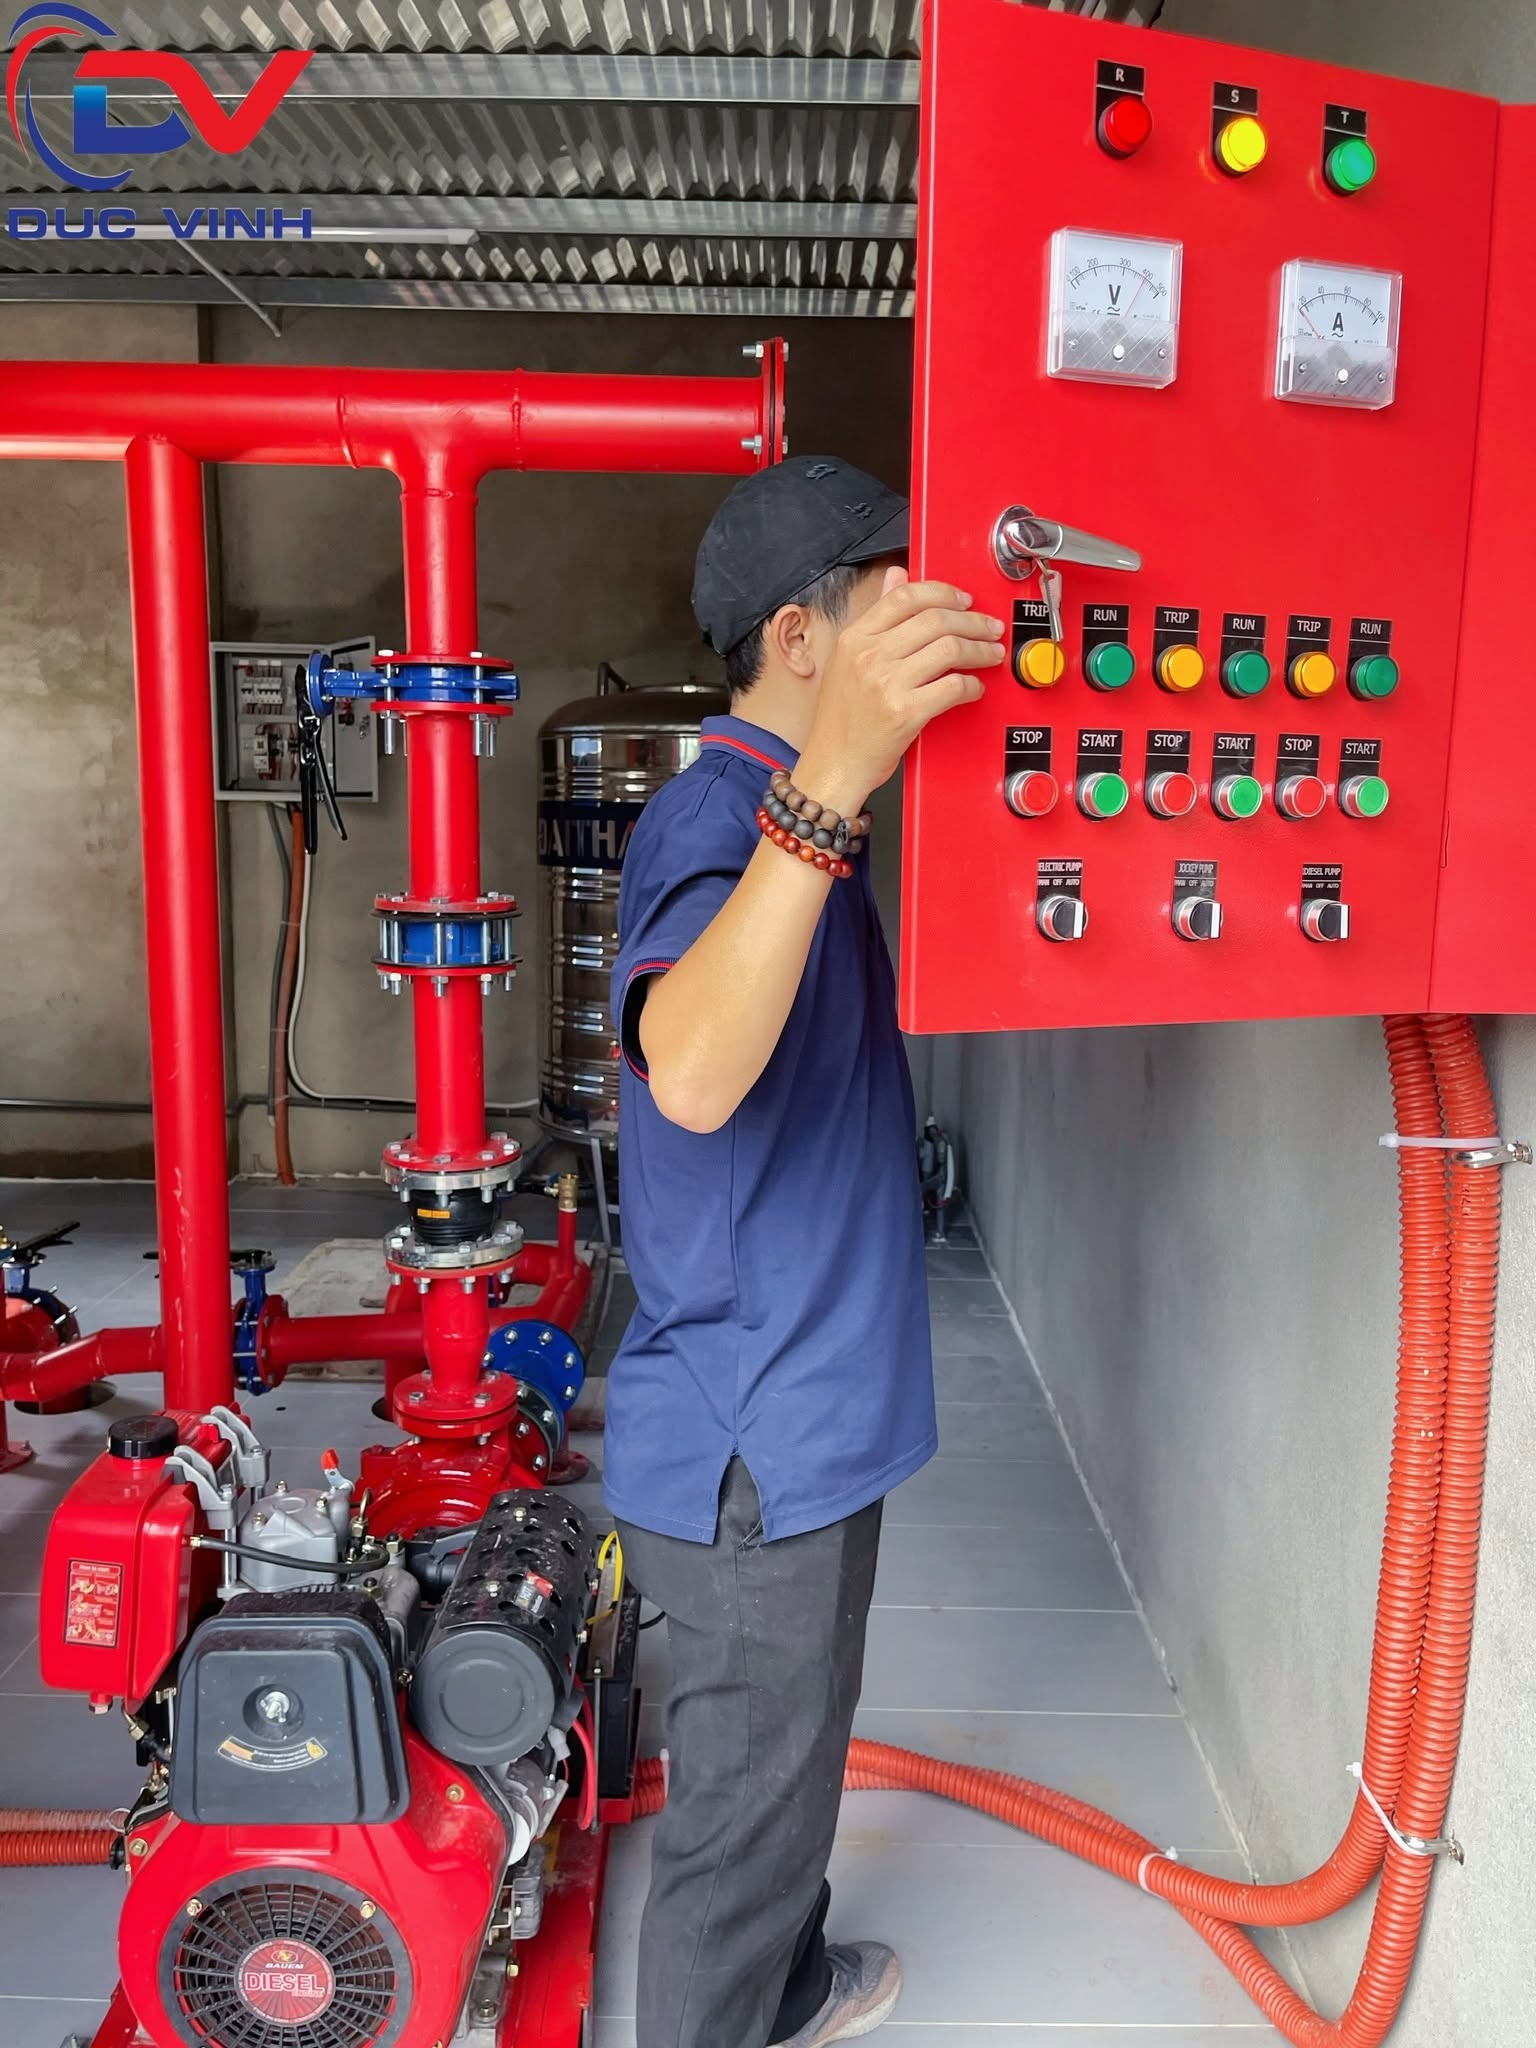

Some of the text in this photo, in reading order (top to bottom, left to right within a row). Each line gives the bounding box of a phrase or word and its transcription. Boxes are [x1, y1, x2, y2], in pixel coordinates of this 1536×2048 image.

[1115, 67, 1125, 82] R
[1230, 89, 1240, 103] S
[1340, 111, 1350, 124] T
[1087, 257, 1099, 268] 200
[1120, 257, 1131, 268] 300
[1108, 284, 1121, 305] V
[1344, 285, 1352, 295] 60
[1332, 312, 1344, 332] A
[1022, 603, 1050, 618] TRIP
[1093, 608, 1118, 622] RUN
[1163, 610, 1190, 624] TRIP
[1232, 617, 1256, 631] RUN
[1296, 620, 1322, 633] TRIP
[1360, 622, 1382, 635] RUN
[1012, 730, 1043, 744] STOP
[1081, 733, 1118, 747] START
[1154, 734, 1183, 748] STOP
[1217, 736, 1251, 750] START
[1285, 738, 1313, 751] STOP
[1345, 742, 1377, 755] START
[1066, 862, 1083, 872] PUMP
[1199, 863, 1214, 874] PUMP
[1303, 867, 1341, 876] DIESEL PUMP
[1052, 878, 1063, 886] OFF
[1065, 878, 1080, 886] AUTO
[244, 1972, 325, 1991] DIESEL
